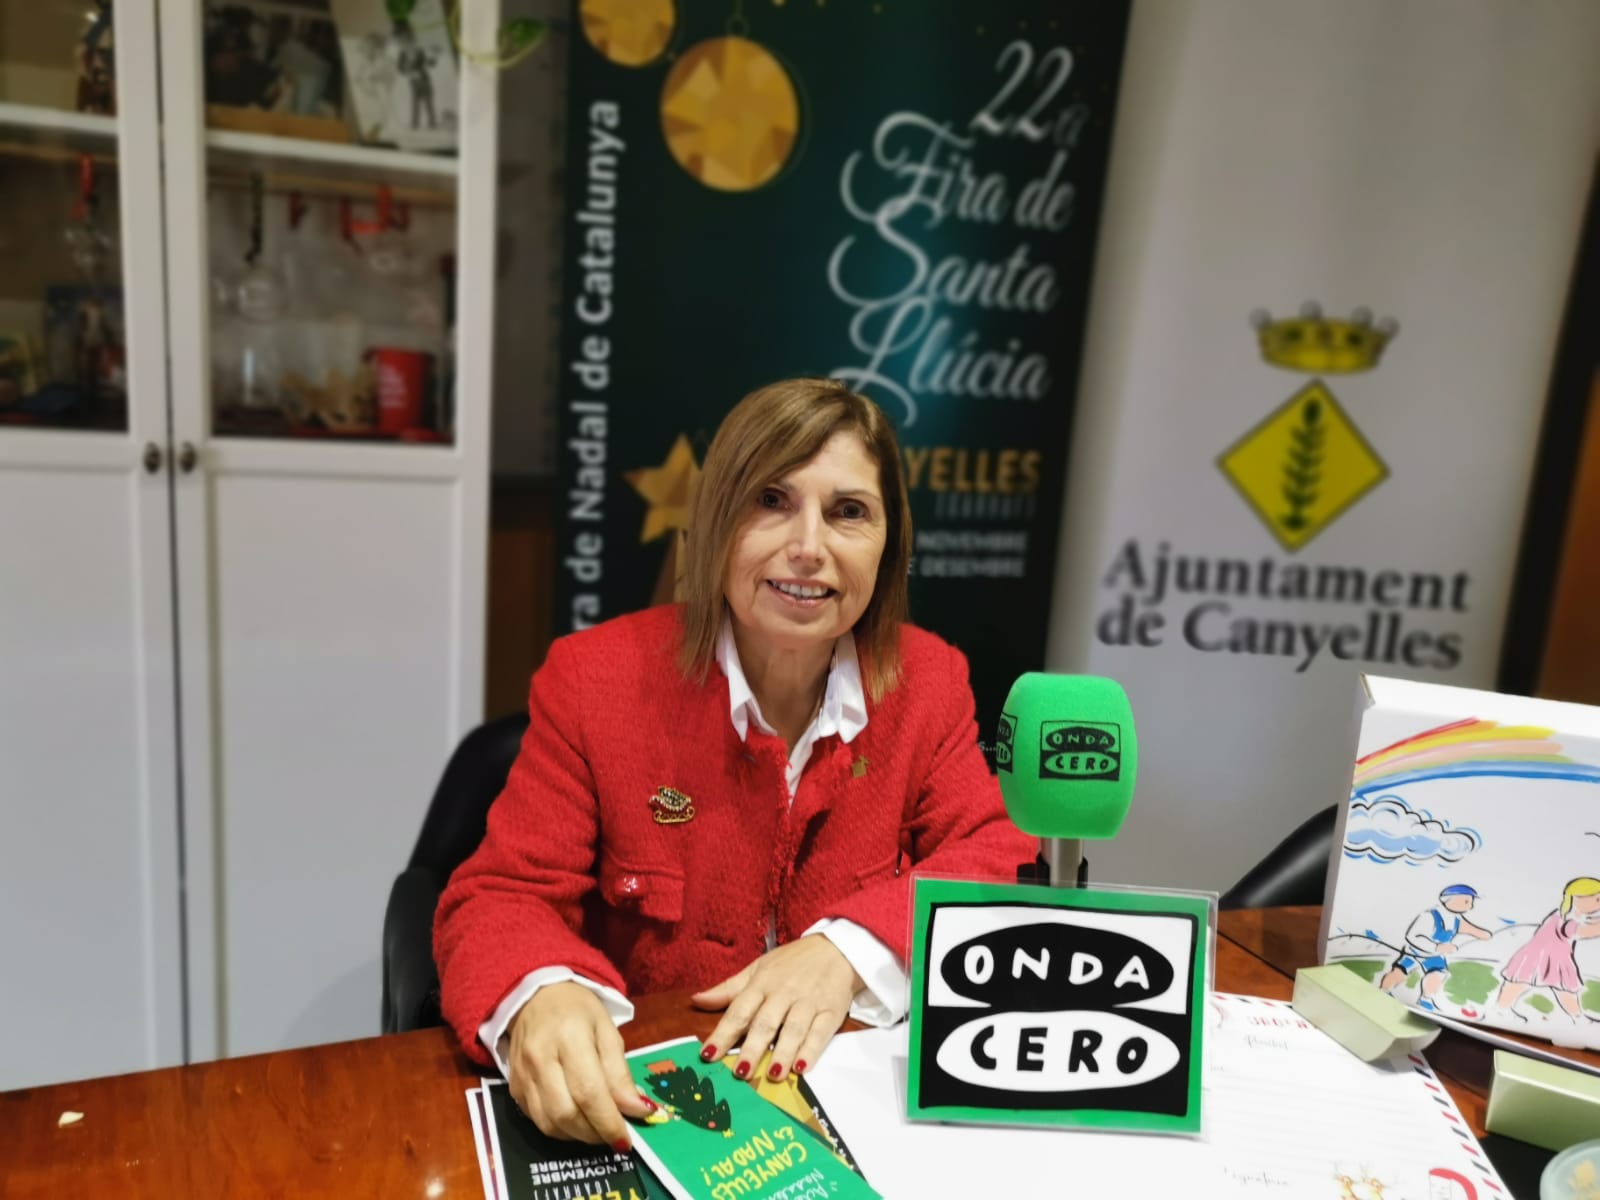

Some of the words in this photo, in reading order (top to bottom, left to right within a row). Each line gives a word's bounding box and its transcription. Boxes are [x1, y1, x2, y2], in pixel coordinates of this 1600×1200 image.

[839, 110, 1006, 224] Fira
[1015, 149, 1076, 230] de
[575, 101, 627, 324] Catalunya
[827, 195, 1058, 312] Santa
[571, 335, 612, 390] de
[829, 297, 1052, 427] Llúcia
[569, 402, 608, 520] Nadal
[564, 531, 604, 583] de
[1103, 538, 1471, 613] Ajuntament
[1096, 594, 1167, 648] de
[1182, 600, 1464, 673] Canyelles
[1052, 732, 1110, 746] ONDA
[1055, 755, 1110, 771] CERO
[964, 945, 1149, 990] ONDA
[970, 1024, 1148, 1075] CERO
[531, 1163, 618, 1186] NOVEMBRE
